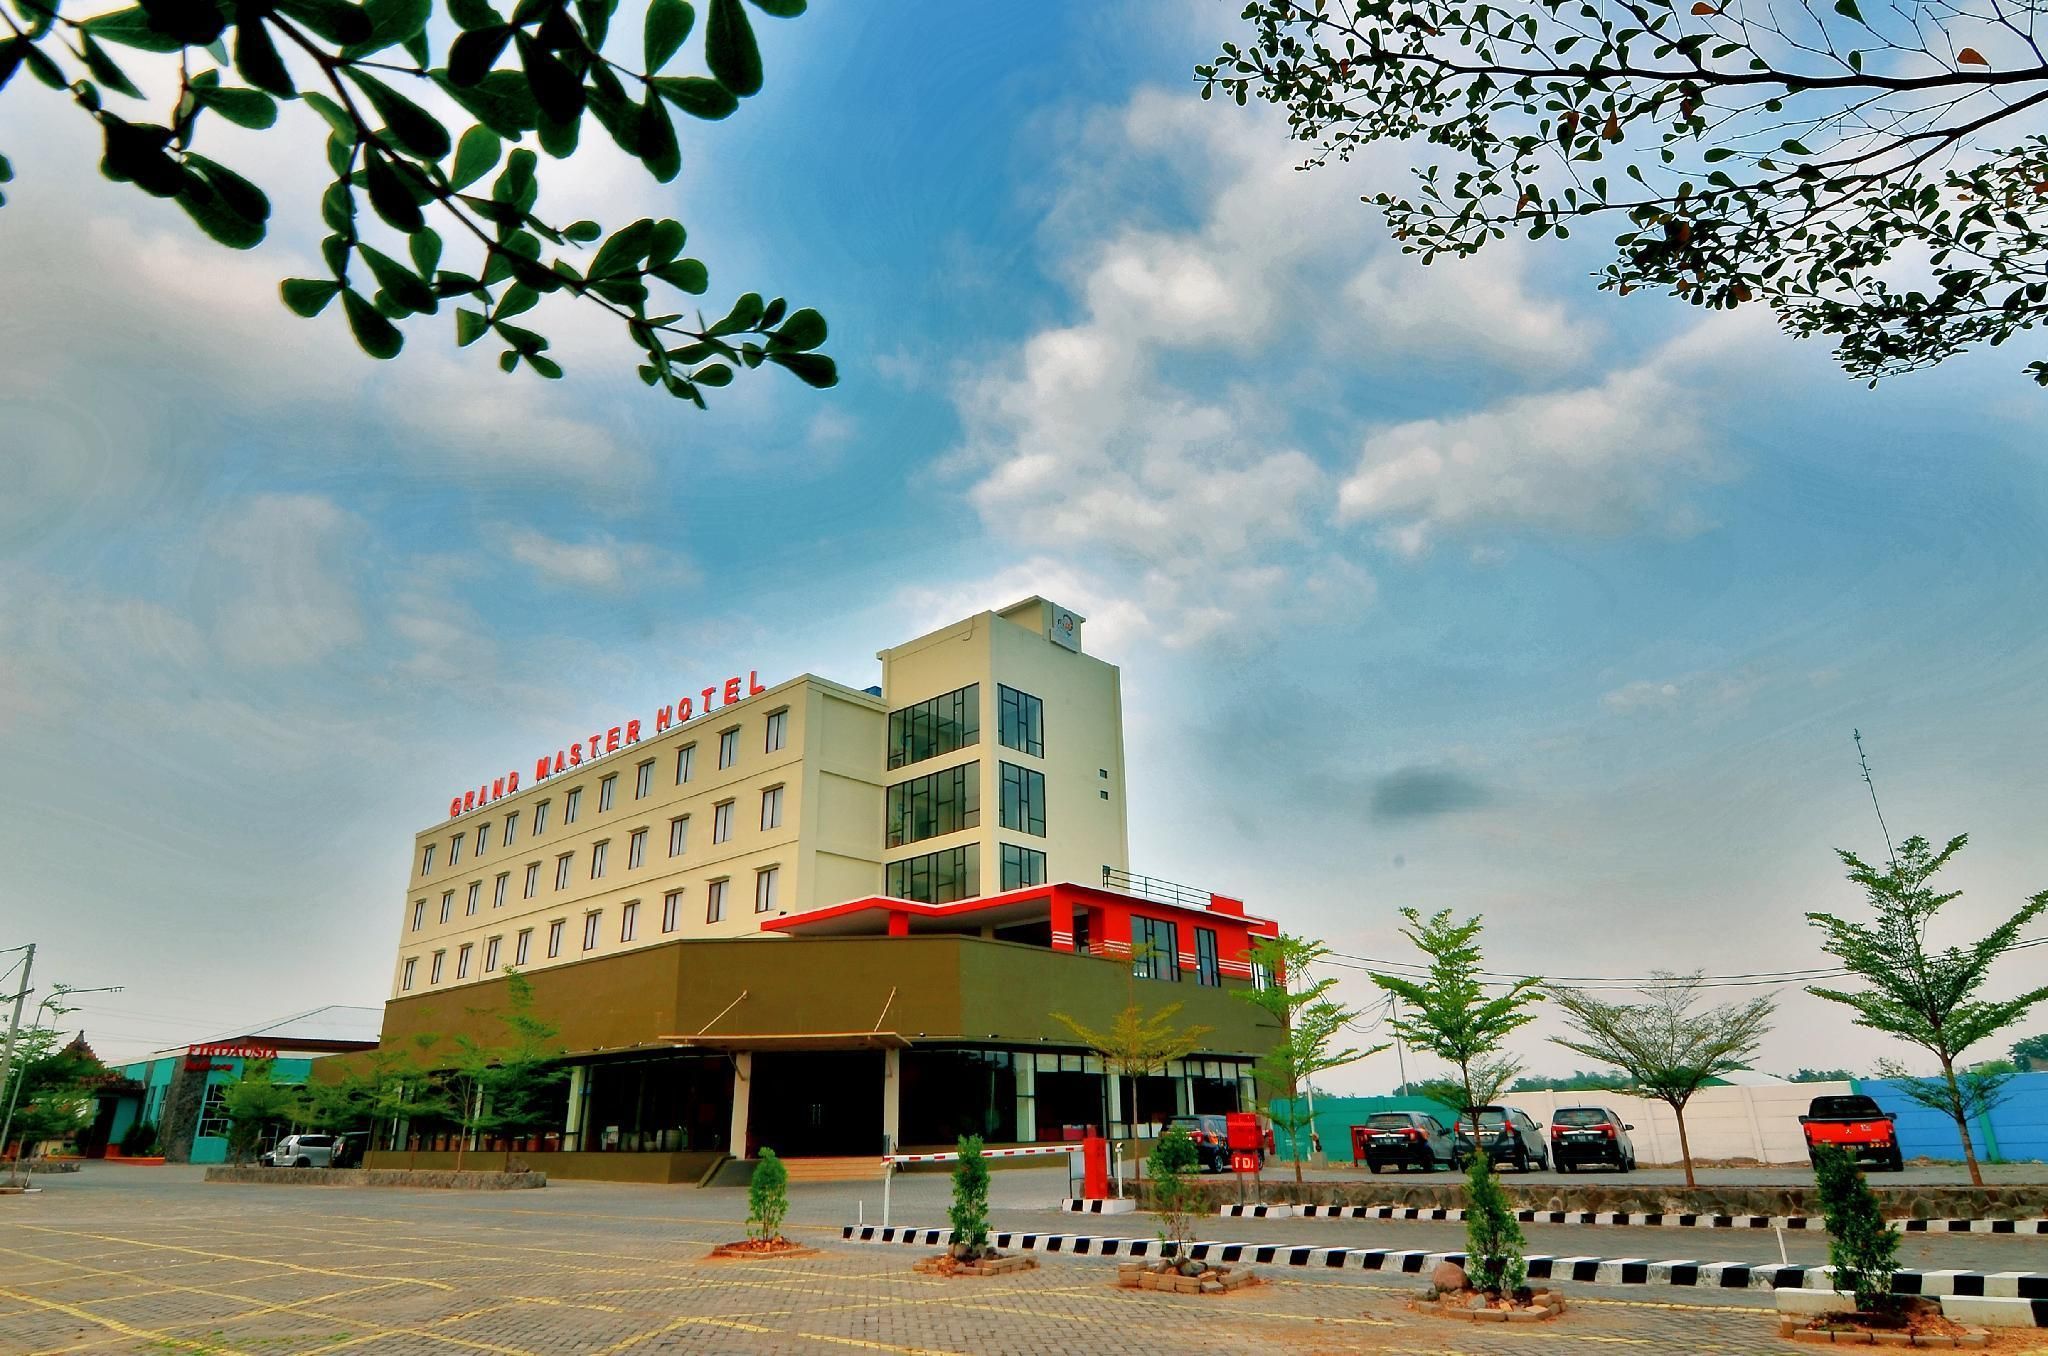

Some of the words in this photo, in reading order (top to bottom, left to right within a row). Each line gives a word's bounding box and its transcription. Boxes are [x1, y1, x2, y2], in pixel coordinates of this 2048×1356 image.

[450, 771, 519, 817] GRAND
[535, 719, 641, 780] MASTER
[655, 670, 766, 732] HOTEL
